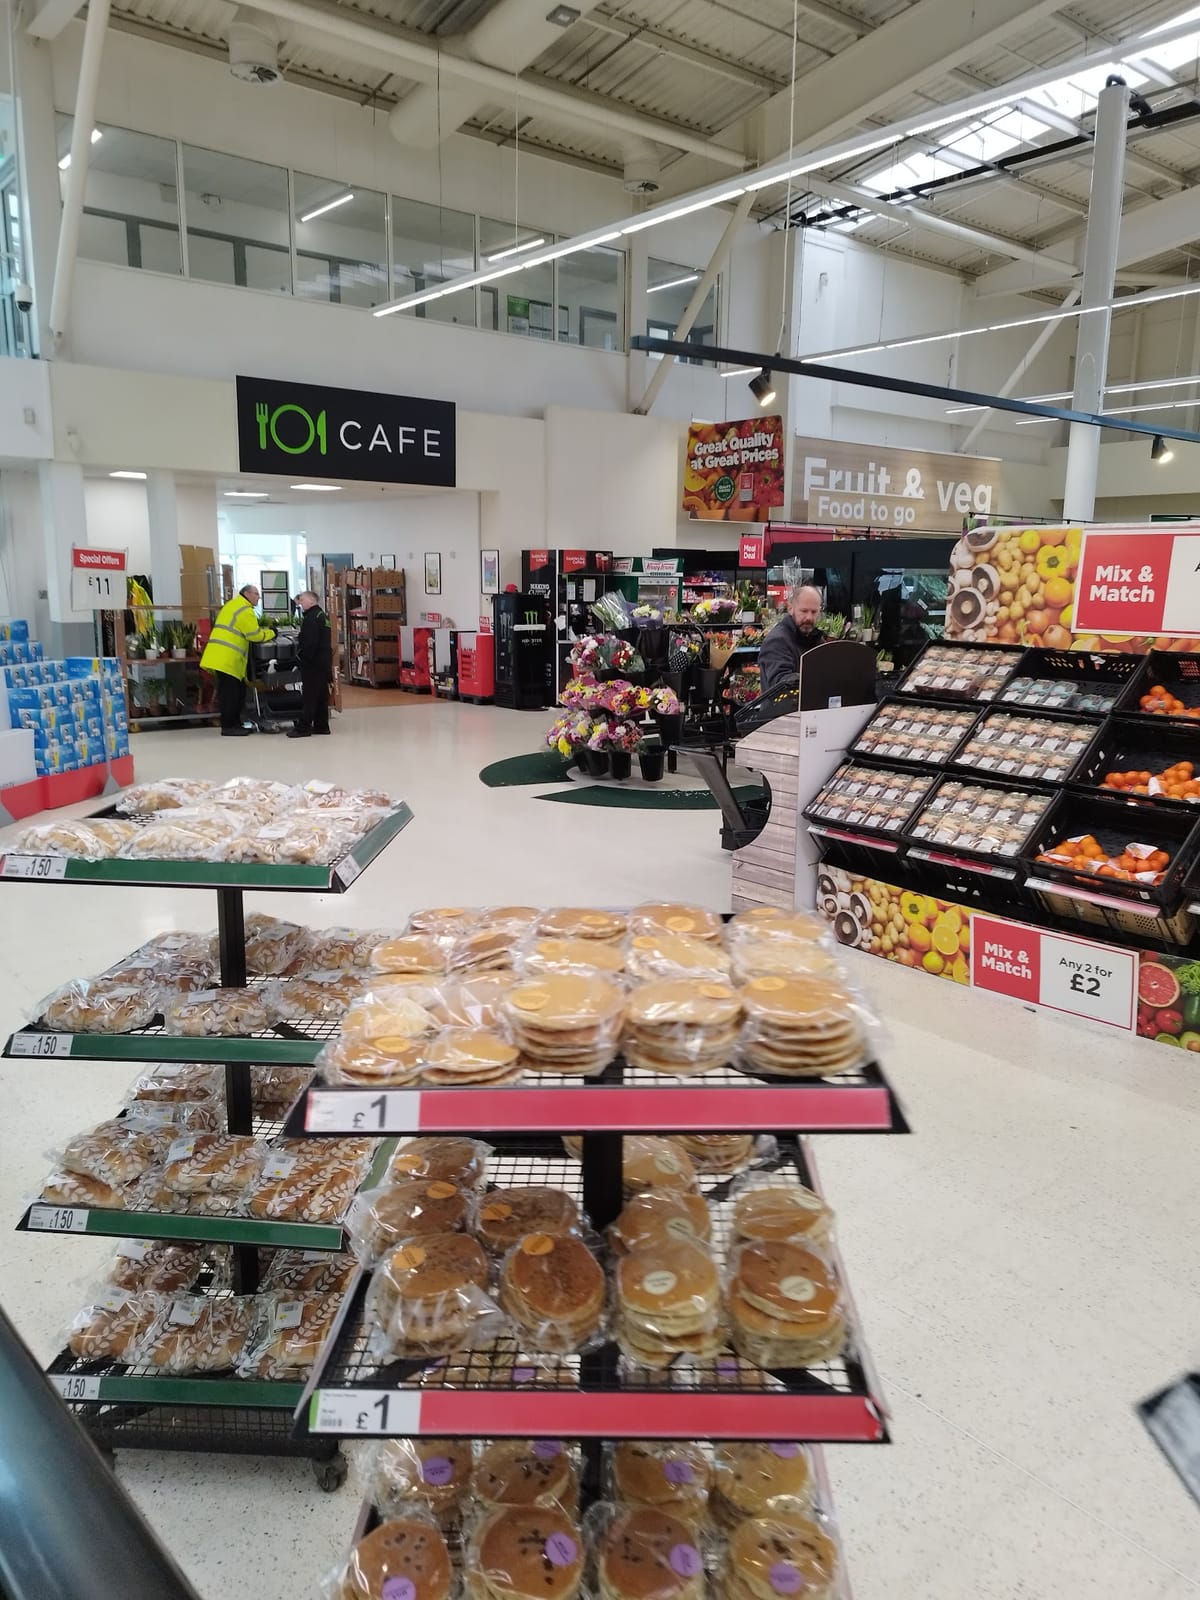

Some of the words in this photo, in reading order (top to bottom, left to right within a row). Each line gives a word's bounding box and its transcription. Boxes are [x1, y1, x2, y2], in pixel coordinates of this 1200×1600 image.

[339, 420, 441, 457] CAFE
[694, 440, 728, 456] Great
[729, 432, 774, 450] Quality
[690, 459, 704, 470] at
[705, 453, 739, 469] Great
[741, 447, 779, 464] Prices
[803, 456, 891, 501] Fruit
[902, 468, 925, 497] &
[936, 480, 993, 519] veg
[818, 495, 865, 521] Food
[870, 501, 889, 521] to
[894, 506, 916, 526] go
[79, 553, 101, 565] Special
[101, 555, 120, 565] Offers
[743, 544, 757, 552] Meal
[743, 551, 756, 560] Deal
[1095, 565, 1133, 583] Mix
[1138, 565, 1154, 583] &
[1089, 585, 1156, 603] Match
[984, 941, 1012, 960] Mix
[1017, 950, 1030, 964] &
[981, 955, 1032, 980] Match
[1058, 957, 1082, 973] Any
[1083, 963, 1093, 974] 2
[1095, 965, 1113, 978] for
[1069, 973, 1101, 997] £2
